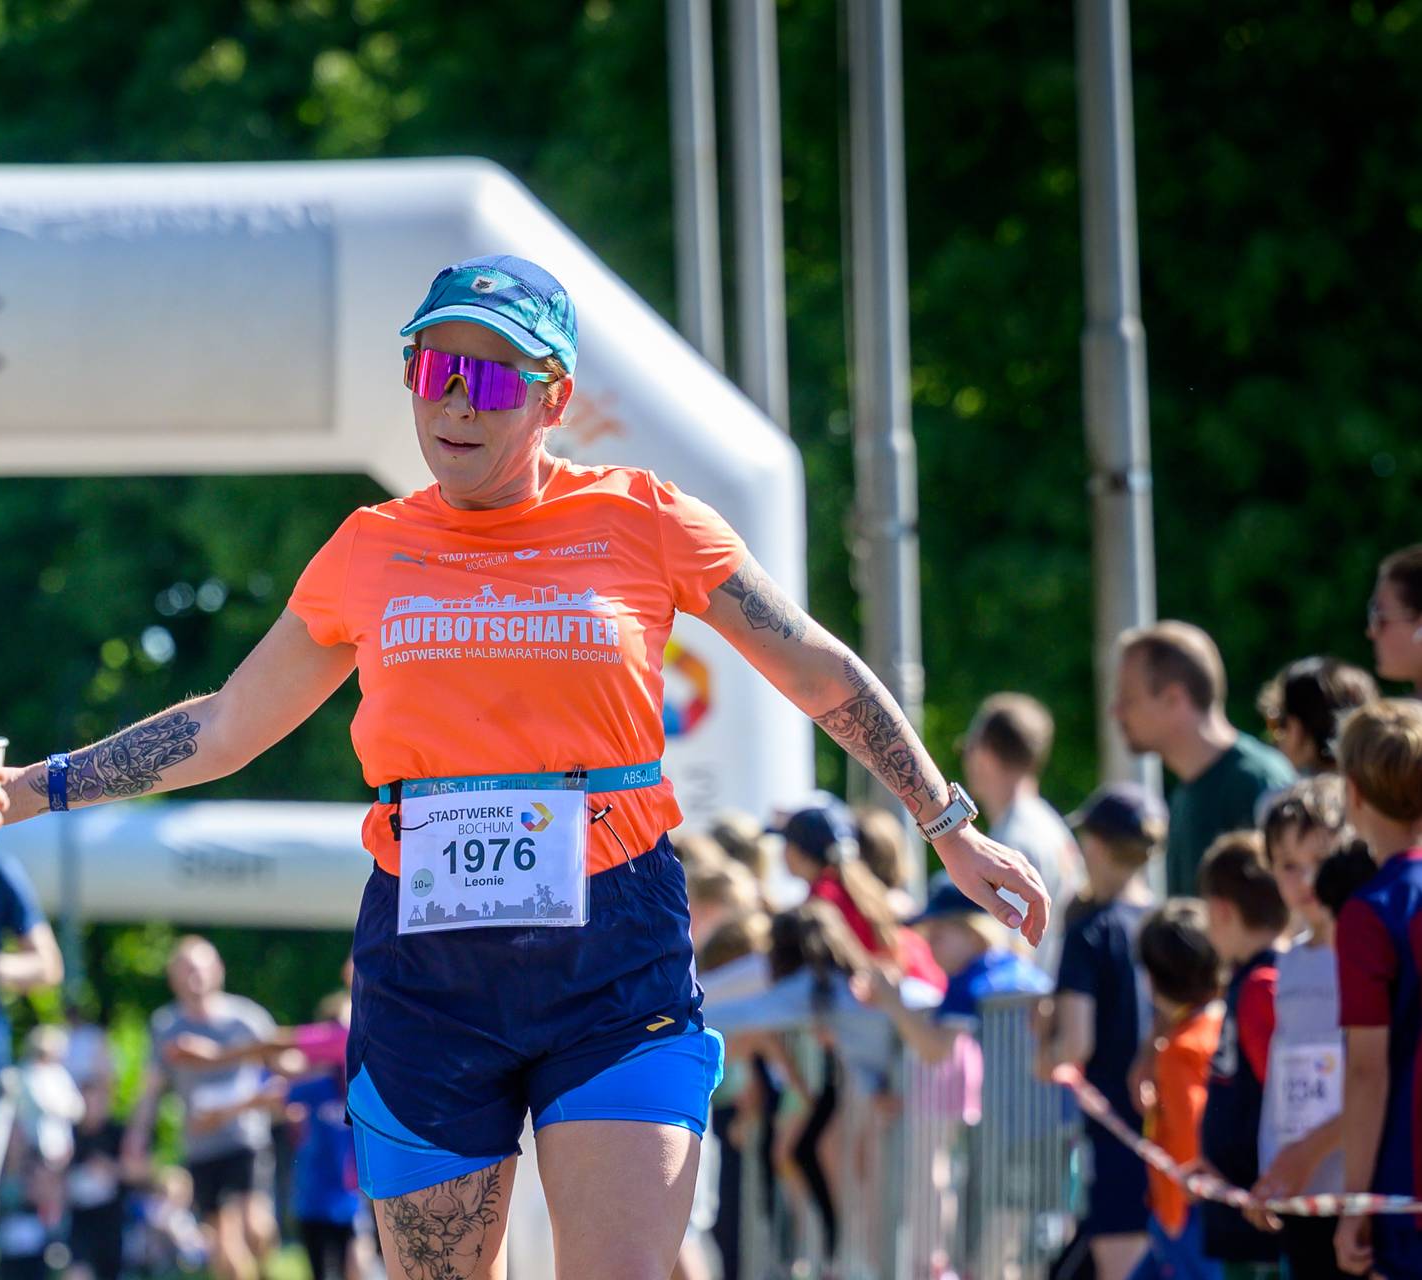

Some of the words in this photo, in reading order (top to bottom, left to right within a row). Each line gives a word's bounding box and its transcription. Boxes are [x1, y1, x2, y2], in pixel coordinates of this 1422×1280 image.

[549, 540, 610, 557] VIACTIV
[465, 554, 509, 572] BOCHUM
[380, 615, 620, 650] LAUFBOTSCHAFTER
[382, 647, 462, 668] STADTWERKE
[465, 647, 568, 661] HALBMARATHON
[571, 648, 623, 665] BOCHUM
[428, 805, 514, 824] STADTWERKE
[458, 820, 514, 835] BOCHUM
[442, 837, 536, 875] 1976
[414, 879, 424, 889] 10
[464, 876, 504, 888] Leonie
